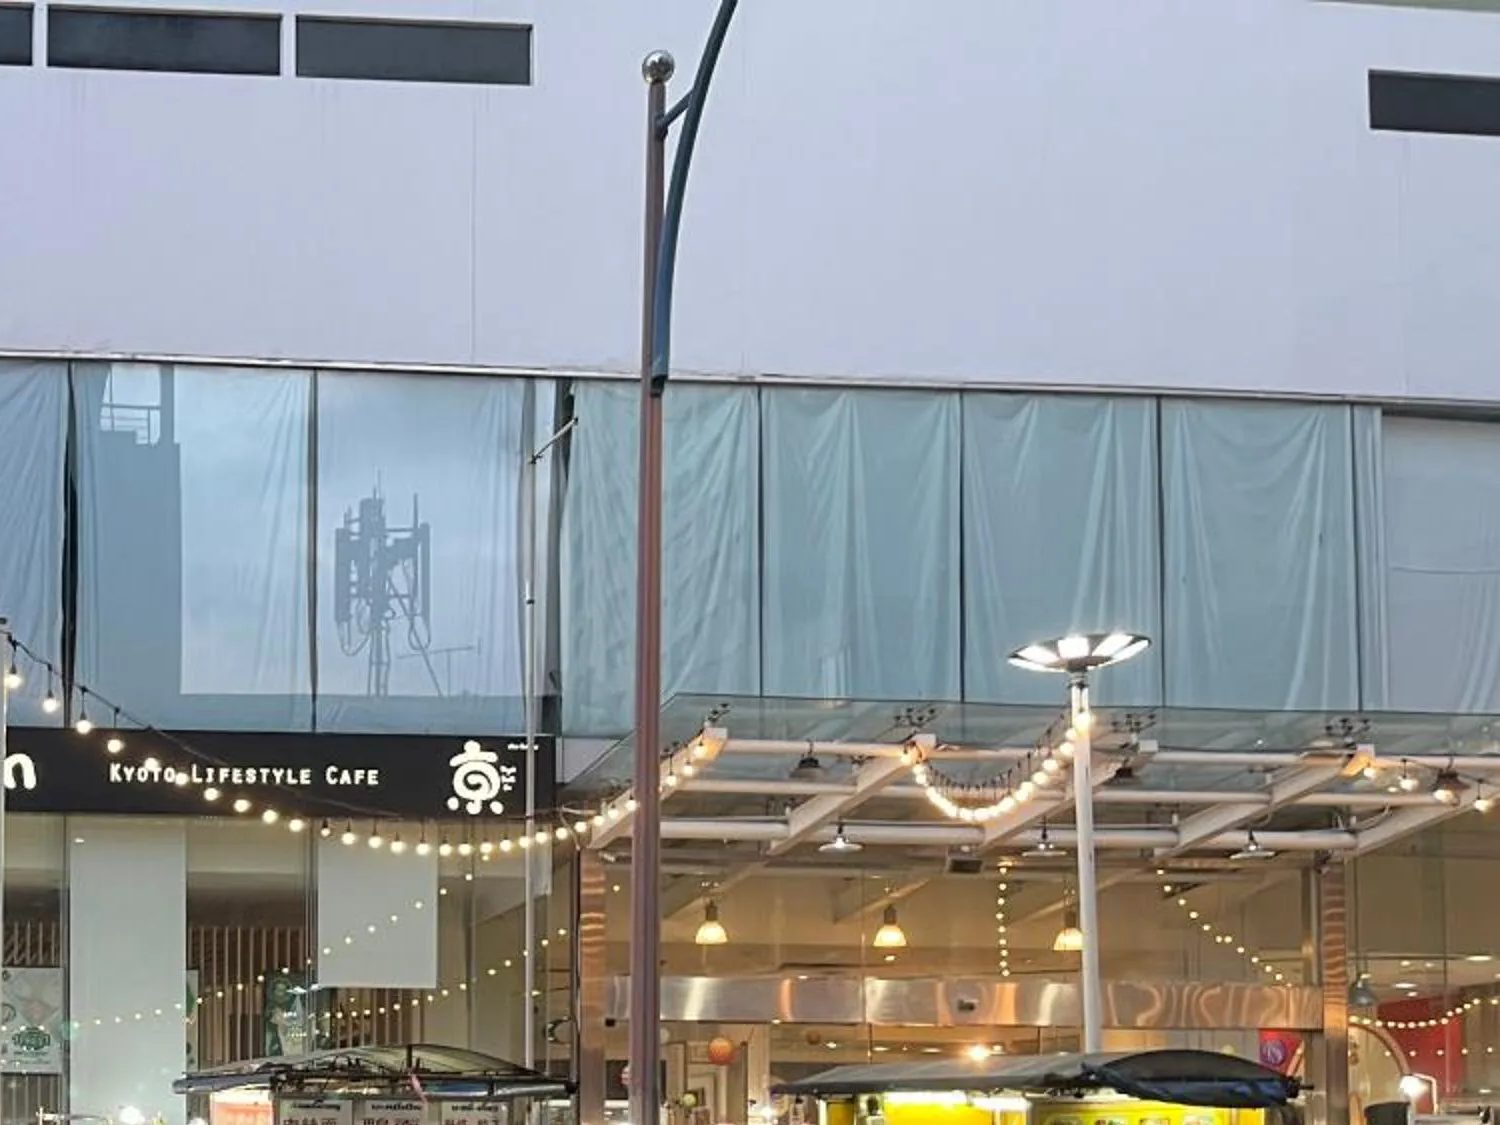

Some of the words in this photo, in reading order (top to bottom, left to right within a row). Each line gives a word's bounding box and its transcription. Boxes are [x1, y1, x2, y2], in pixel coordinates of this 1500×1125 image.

[109, 763, 176, 783] KYOTO
[191, 763, 312, 785] LIFESTYLE
[325, 765, 379, 785] CAFE
